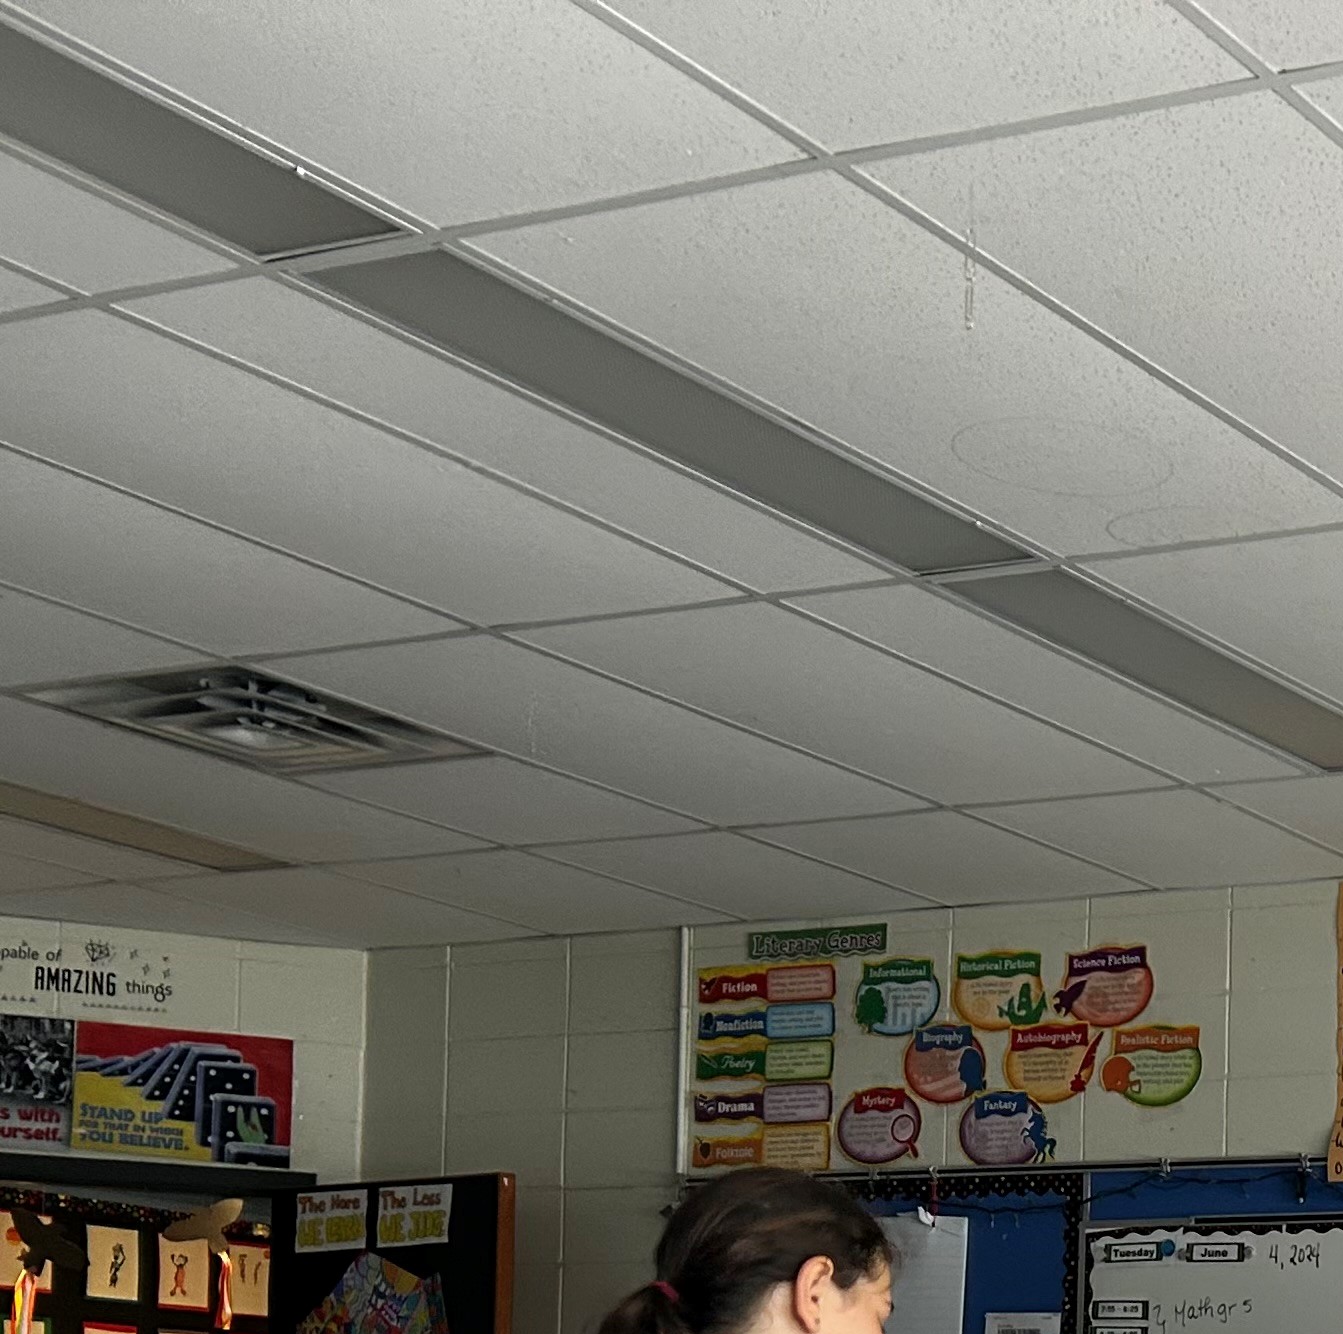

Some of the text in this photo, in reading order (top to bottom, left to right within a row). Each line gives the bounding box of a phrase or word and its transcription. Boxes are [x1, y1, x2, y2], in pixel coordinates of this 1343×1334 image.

[752, 930, 881, 956] Literary Genres
[46, 948, 62, 961] of
[1074, 954, 1141, 969] Science Fiction
[869, 965, 926, 978] Informational
[960, 959, 1035, 972] Historical Fiction
[35, 966, 117, 997] AMAZING
[722, 981, 757, 994] Fiction
[126, 980, 173, 1002] things
[716, 1018, 765, 1032] Nonfiction
[922, 1031, 963, 1045] Biography
[1016, 1031, 1083, 1045] Autobiography
[1121, 1034, 1194, 1046] Realistic Fiction
[720, 1055, 756, 1072] Poetry
[718, 1101, 755, 1113] Drama
[862, 1095, 896, 1107] Mystery
[984, 1100, 1017, 1112] Fantasy
[17, 1106, 60, 1123] with
[80, 1104, 162, 1124] STAND UP
[80, 1130, 189, 1150] YOU BELIEVE.
[299, 1194, 360, 1214] The More
[382, 1187, 441, 1210] The Less
[1113, 1248, 1155, 1258] Tuesday
[1200, 1248, 1228, 1258] June
[1289, 1243, 1321, 1268] 2024
[1175, 1296, 1214, 1327] Math
